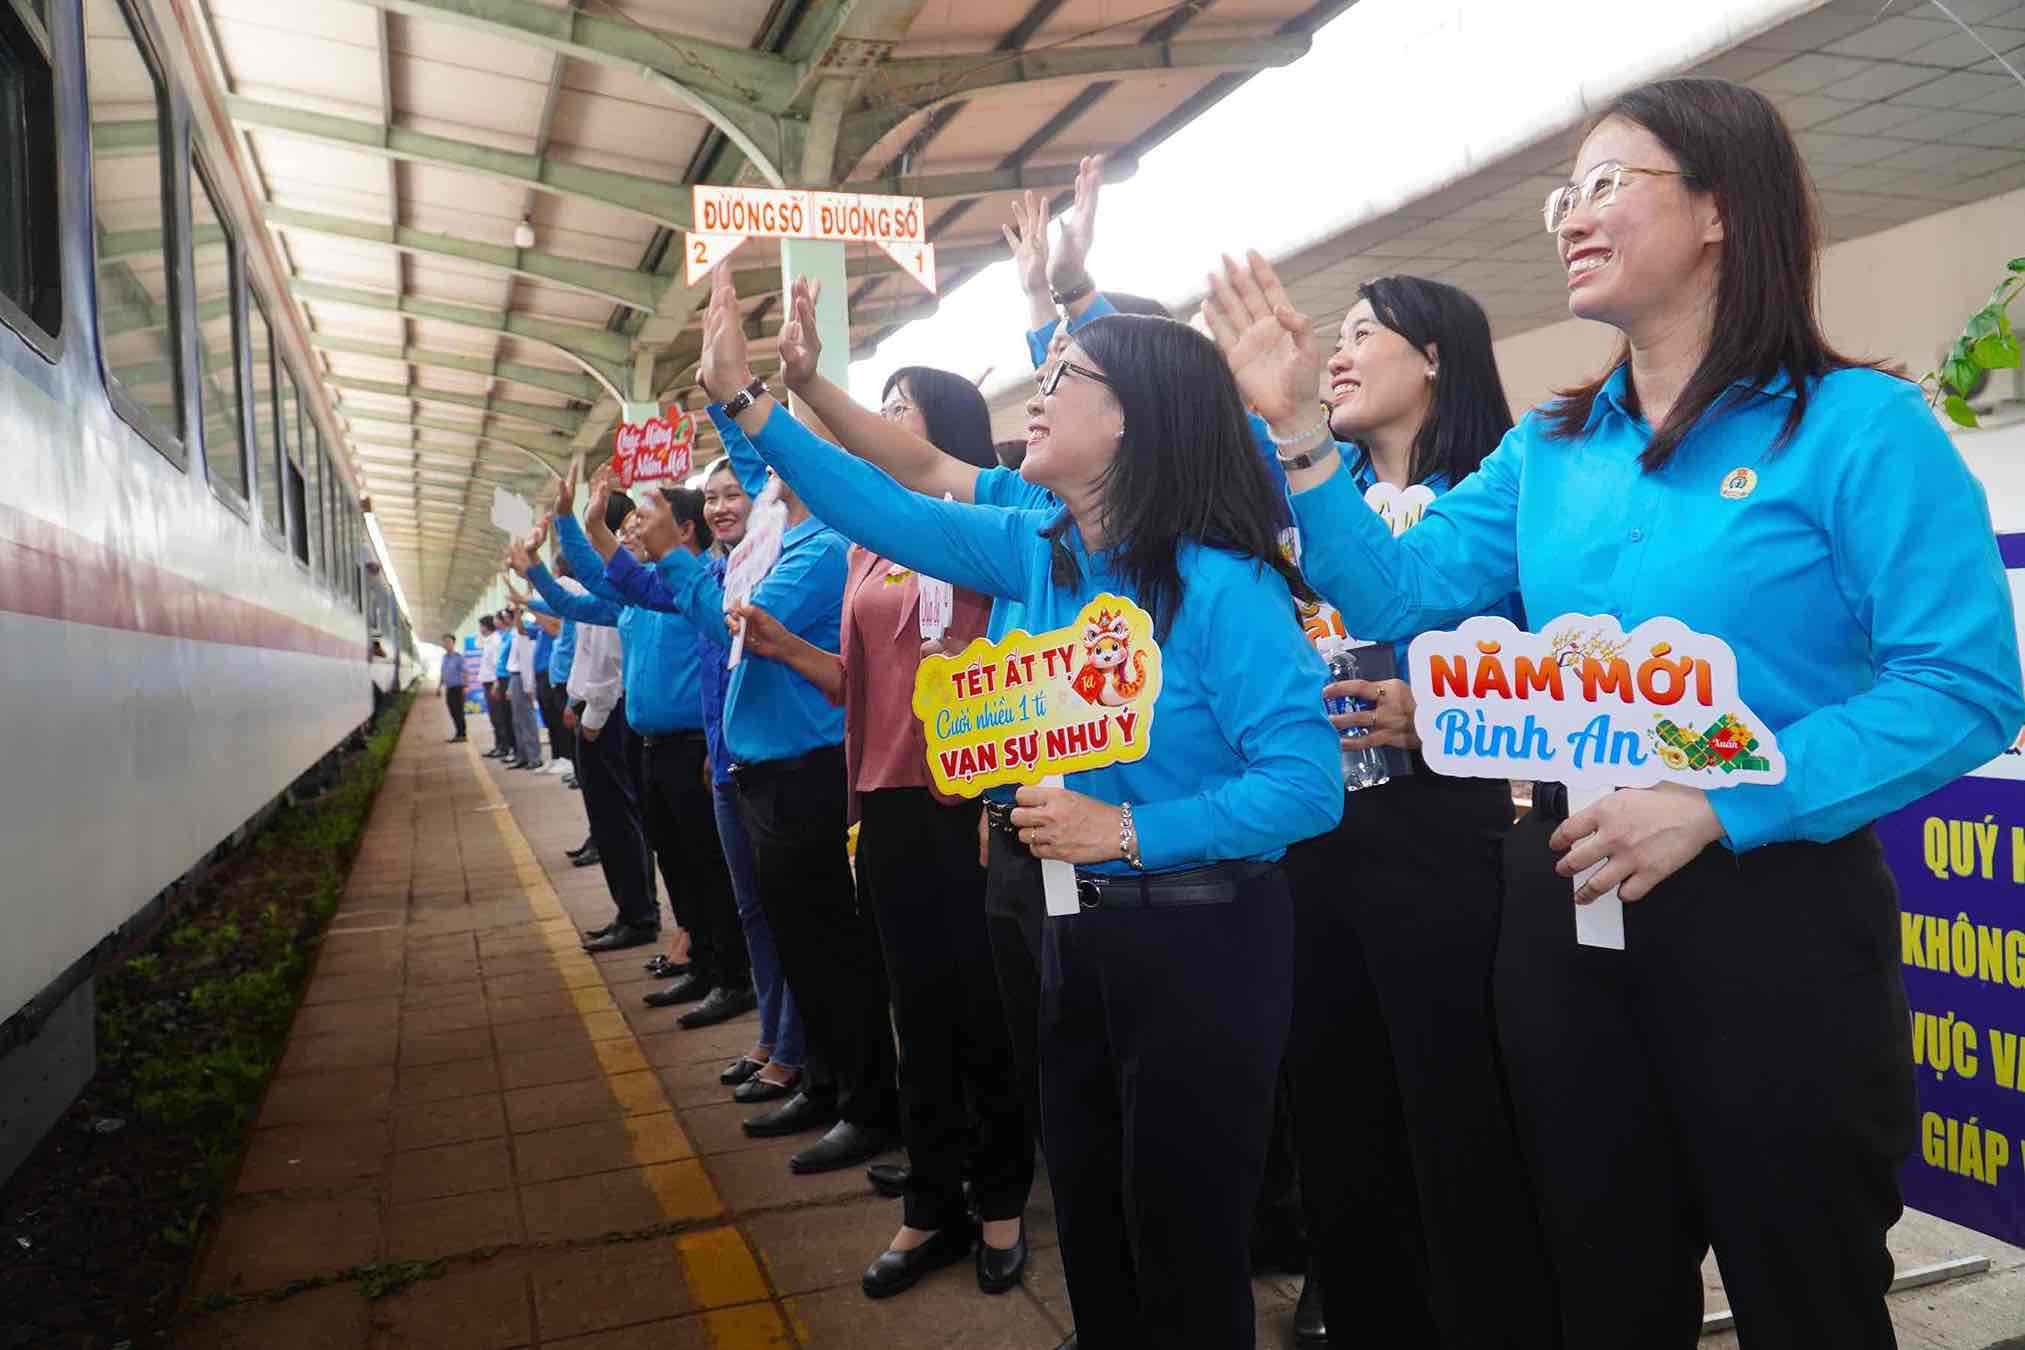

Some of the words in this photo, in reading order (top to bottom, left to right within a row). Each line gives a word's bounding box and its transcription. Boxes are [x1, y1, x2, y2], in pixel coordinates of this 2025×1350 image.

[694, 241, 708, 264] 2
[915, 251, 924, 273] 1
[952, 656, 997, 699] TẾT
[1004, 647, 1035, 688] ẤT
[1042, 643, 1076, 681] TỴ
[1429, 640, 1564, 701] NĂM
[1581, 641, 1713, 707] MỚI
[976, 696, 1016, 730] nhiều
[1019, 701, 1030, 721] 1
[1032, 690, 1047, 717] tí
[1435, 708, 1556, 761] Bình
[1567, 714, 1648, 769] An
[940, 743, 998, 782] VẠN
[1004, 729, 1040, 769] SỰ
[1047, 715, 1110, 758] NHƯ
[1115, 705, 1138, 744] Ý
[1923, 814, 1999, 880] QUÝ
[1901, 911, 2025, 989] KHÔNG
[1909, 1008, 1978, 1081] VỰC
[1922, 1111, 2009, 1186] GIÁP
